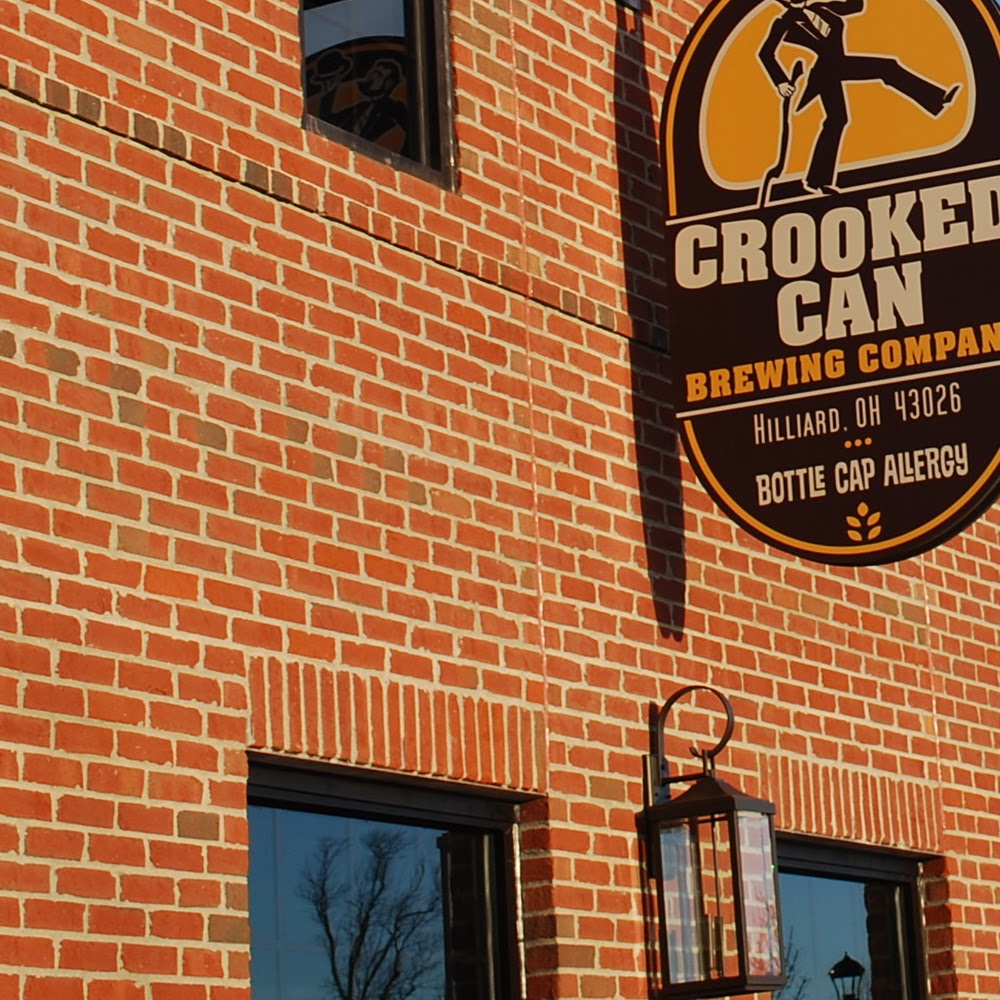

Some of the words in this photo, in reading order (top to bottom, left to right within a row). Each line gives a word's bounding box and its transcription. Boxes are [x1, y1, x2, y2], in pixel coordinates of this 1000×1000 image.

[777, 261, 925, 347] CAN
[685, 349, 845, 402] BREWING
[855, 395, 881, 428] OH
[895, 382, 962, 421] 43026
[756, 464, 826, 506] BOTTLE
[834, 457, 876, 494] CAP
[883, 442, 969, 487] ALLERGY
